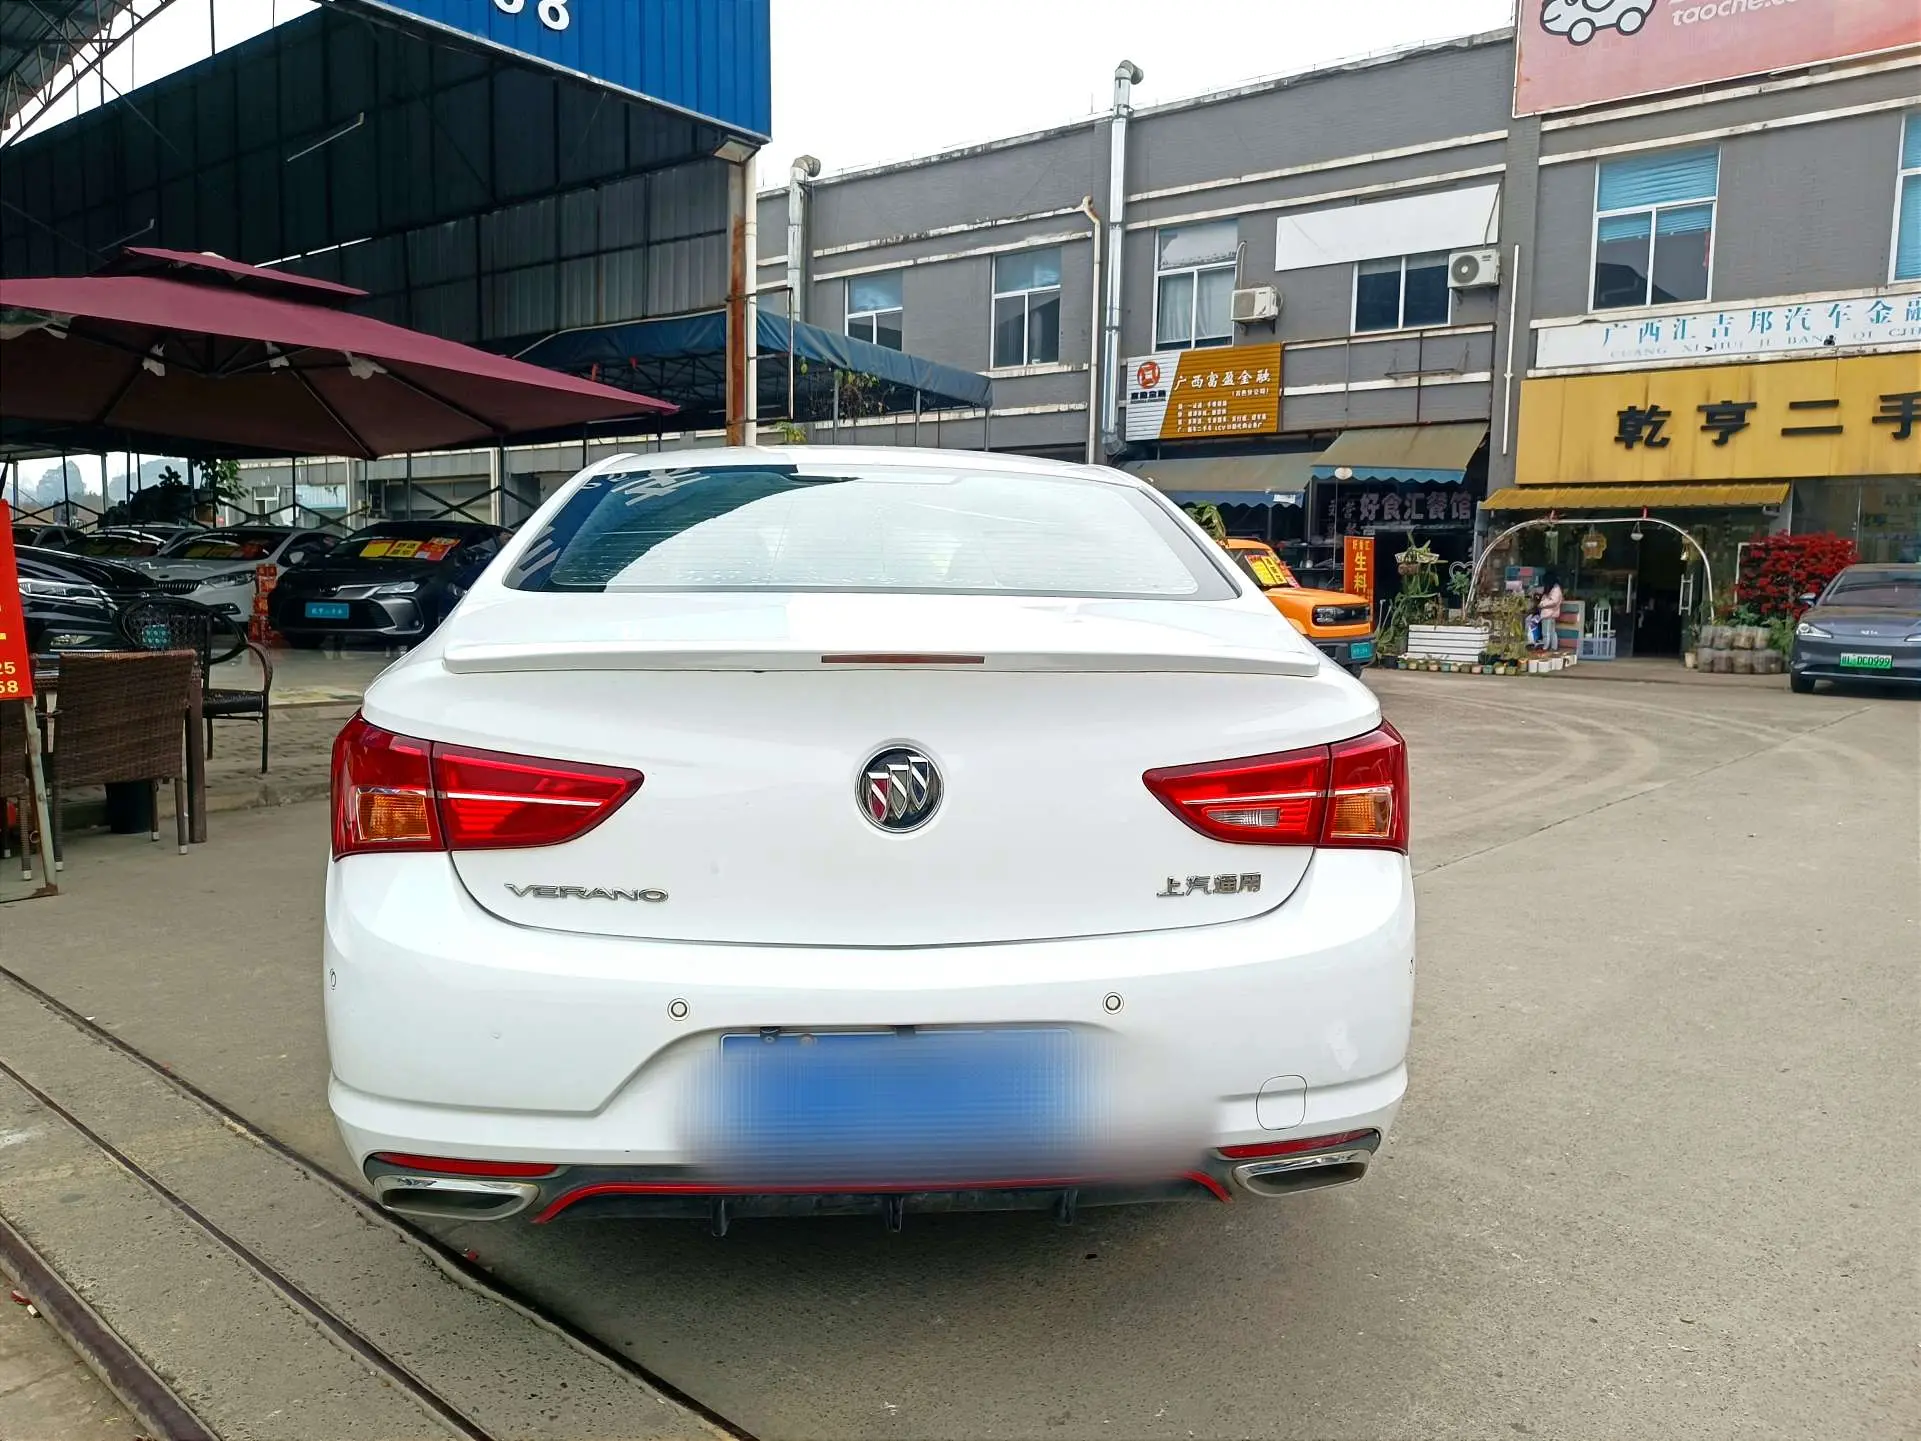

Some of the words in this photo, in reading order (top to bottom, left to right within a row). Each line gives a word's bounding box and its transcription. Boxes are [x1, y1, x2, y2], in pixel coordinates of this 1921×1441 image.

[1174, 369, 1271, 390] 广西富盈金融
[1359, 491, 1471, 521] 好食汇餐馆
[504, 883, 668, 902] VERANO
[1156, 871, 1261, 898] 上汽通用
